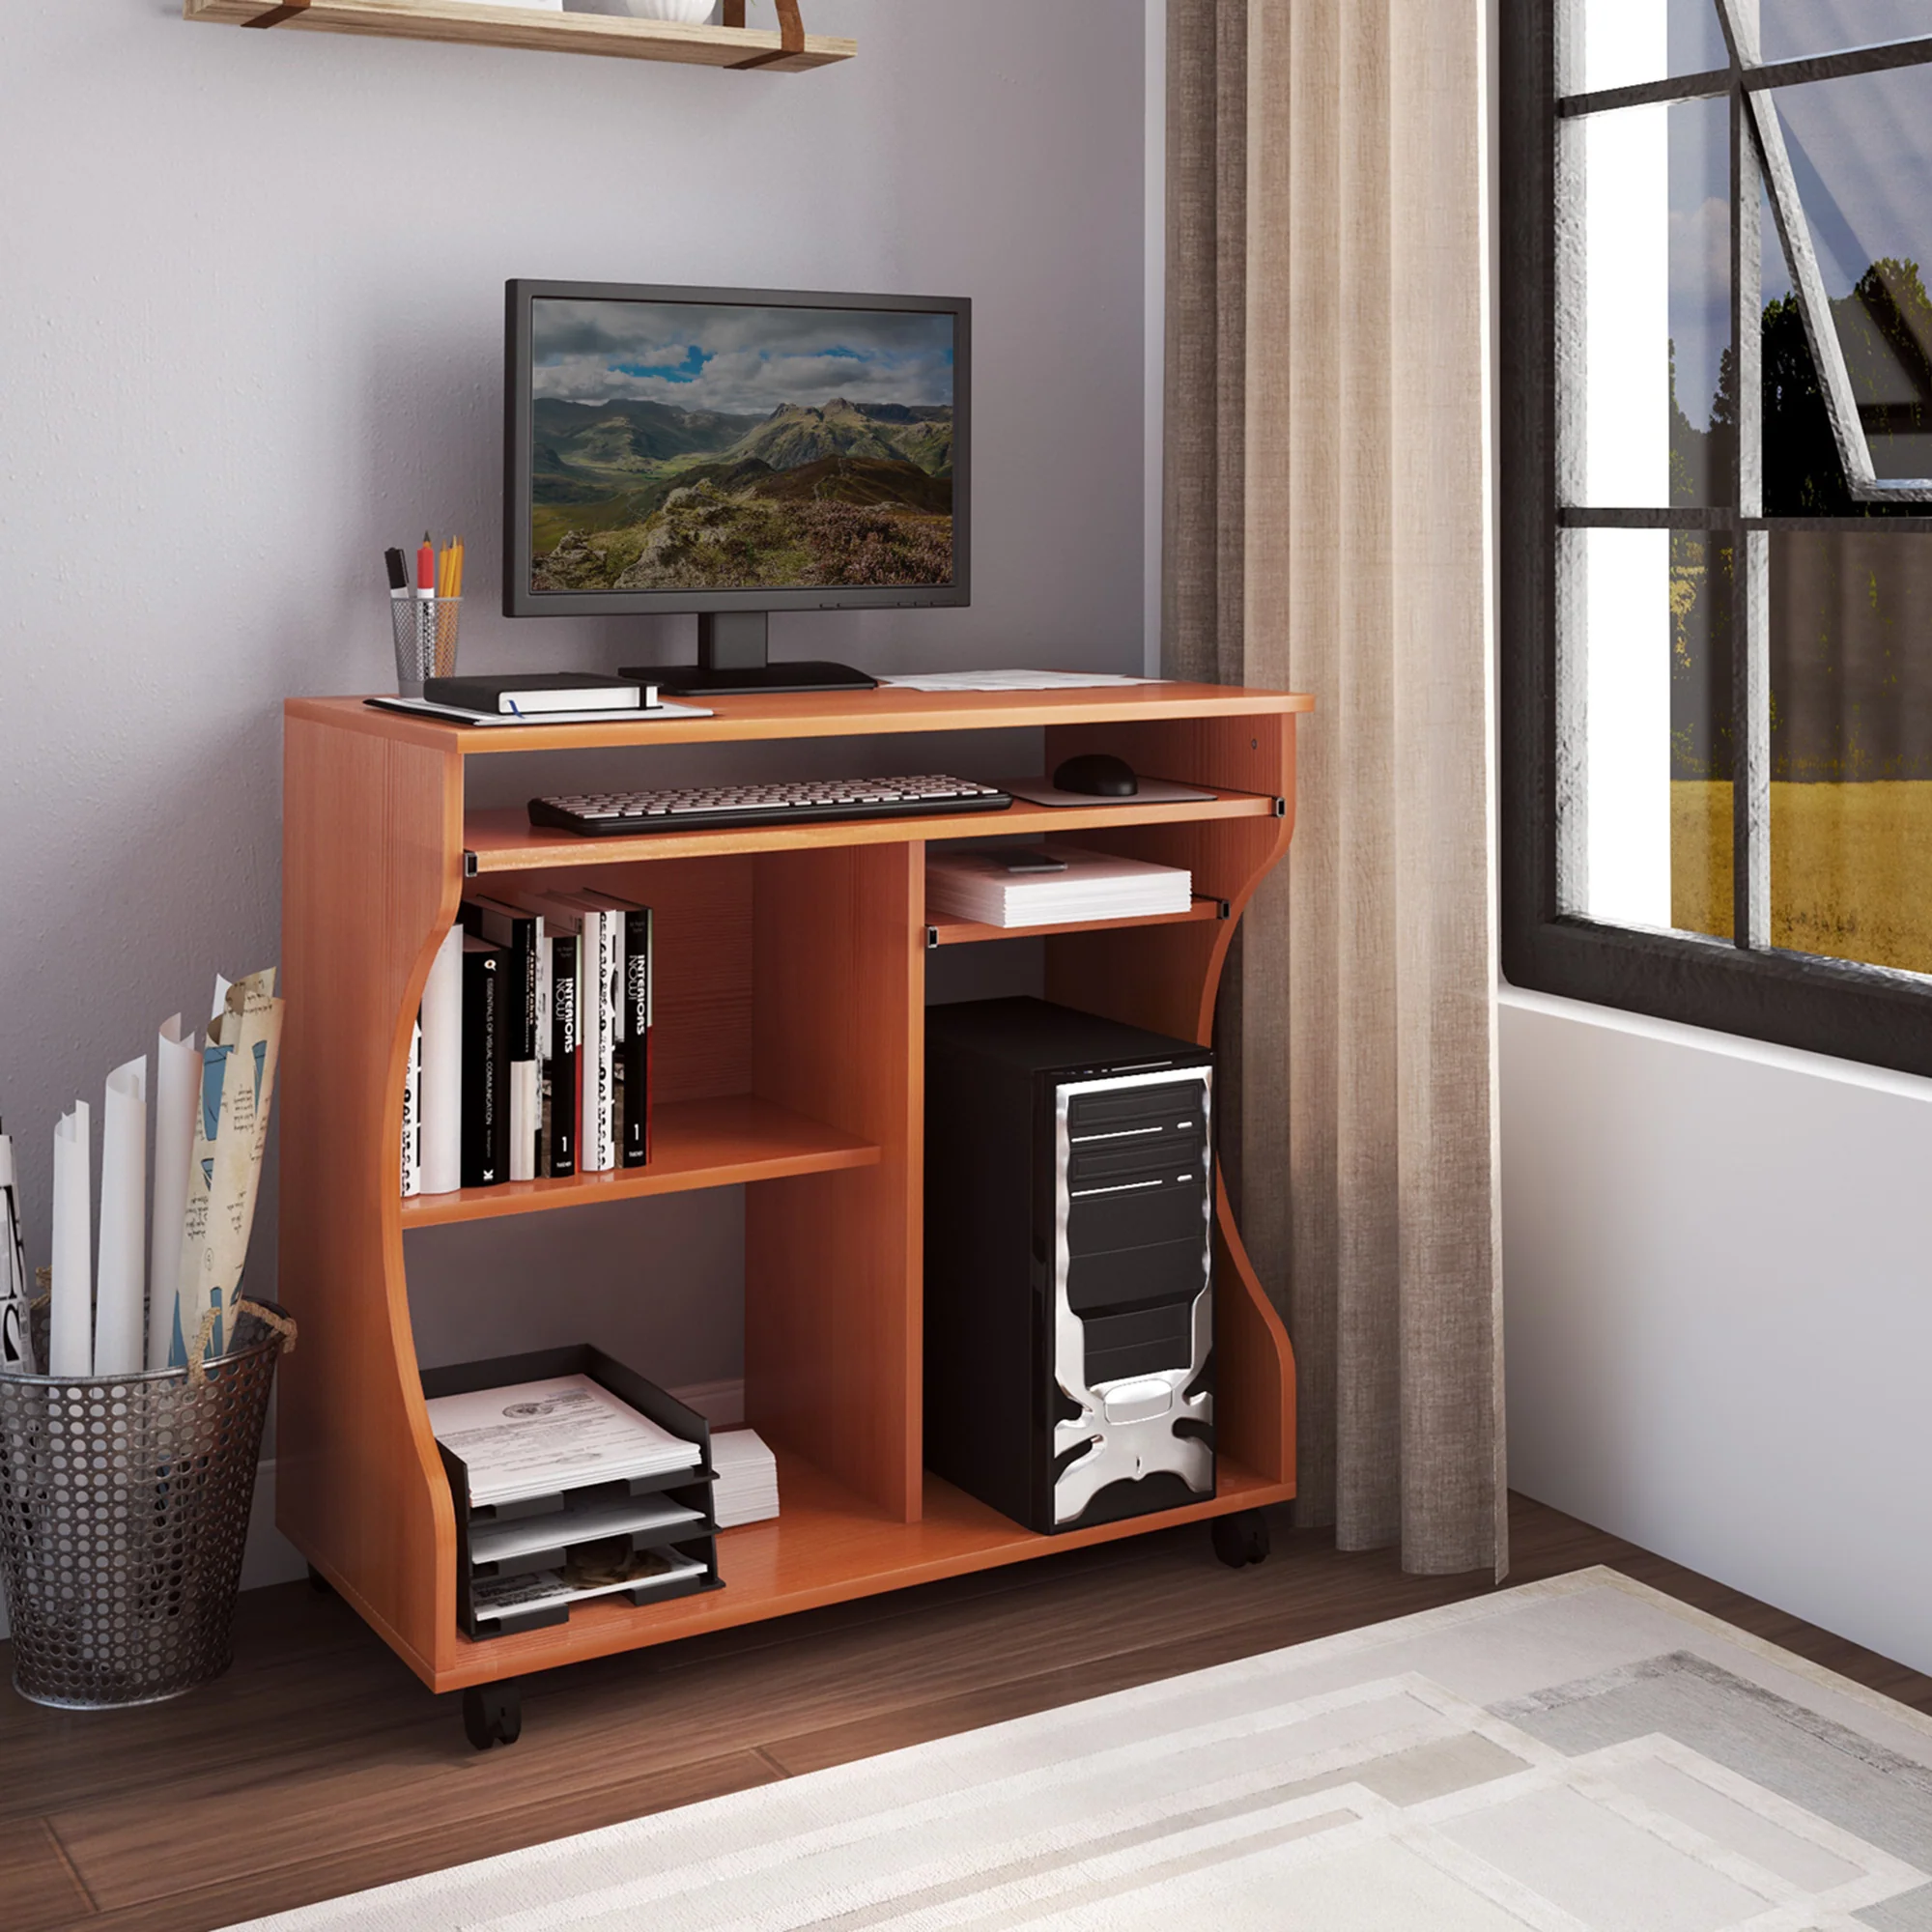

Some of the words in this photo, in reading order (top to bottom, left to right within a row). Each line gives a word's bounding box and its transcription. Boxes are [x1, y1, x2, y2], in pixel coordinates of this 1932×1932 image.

[636, 954, 645, 1036] INTERIORS
[564, 978, 574, 1054] INTERIORS
[486, 1022, 494, 1034] OF
[634, 1122, 639, 1141] 1
[561, 1135, 567, 1152] 1
